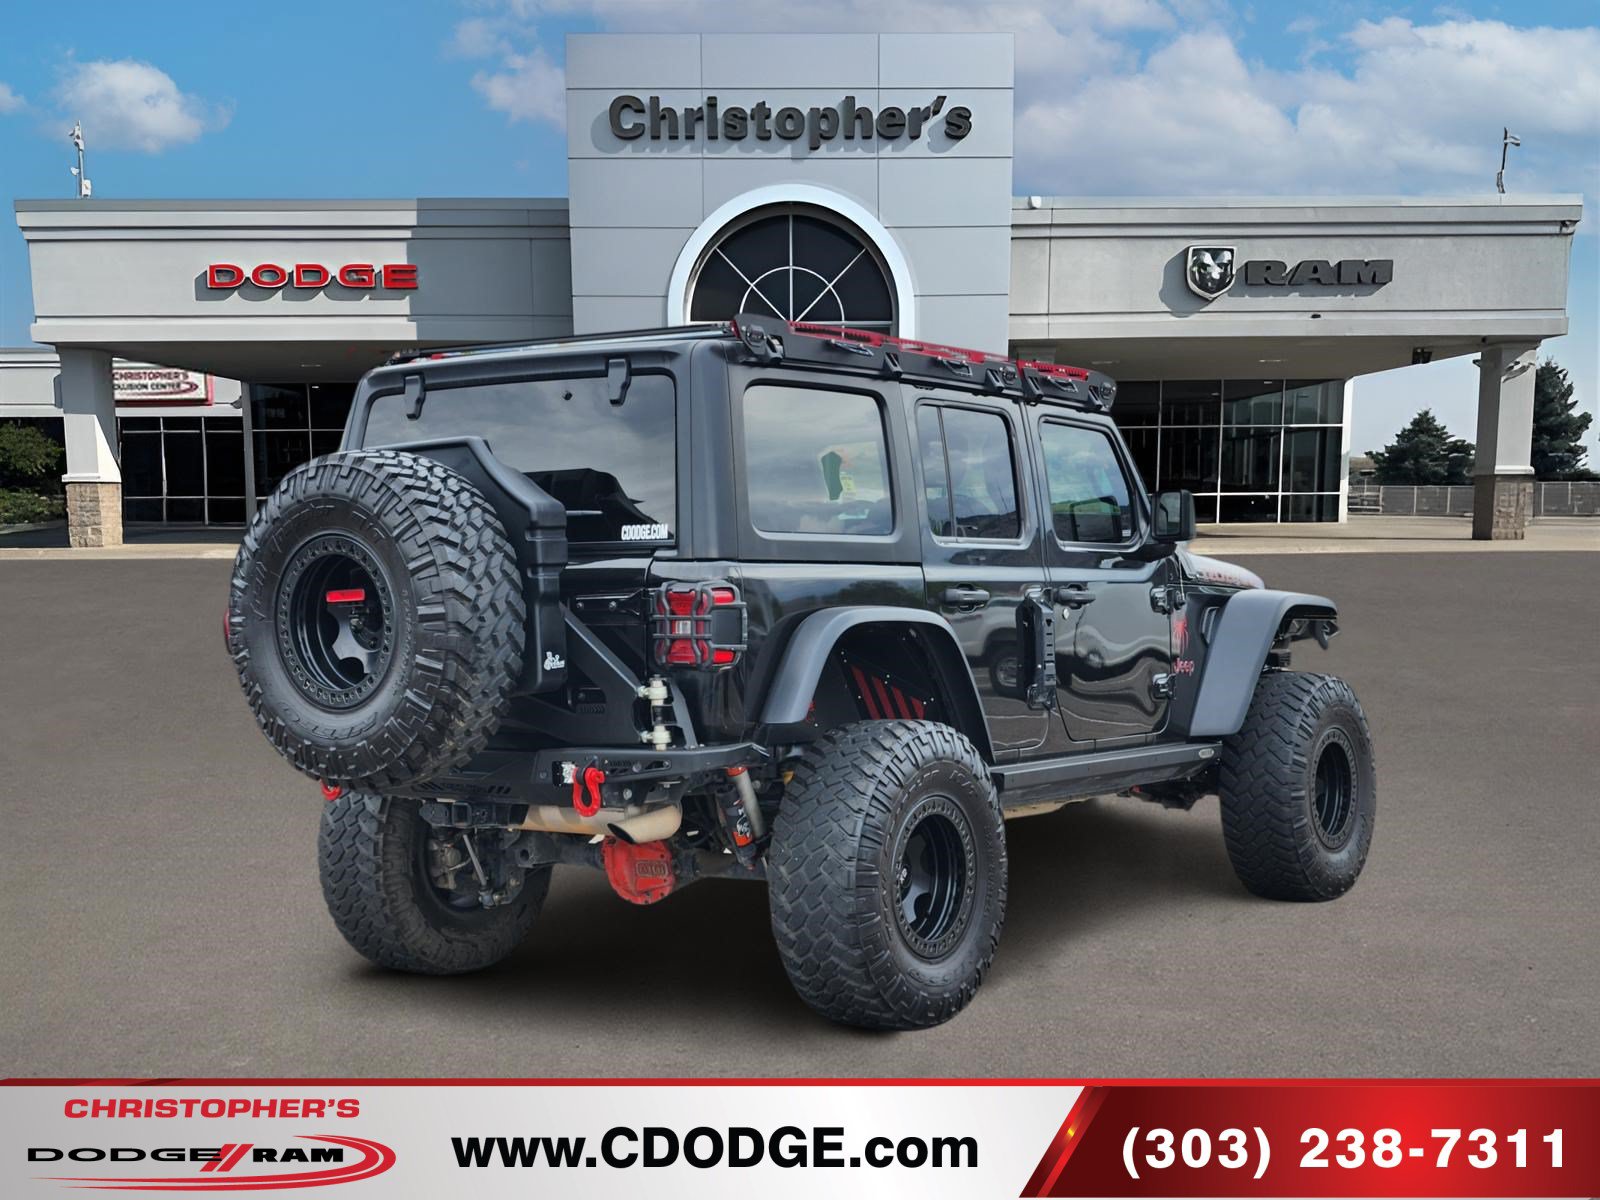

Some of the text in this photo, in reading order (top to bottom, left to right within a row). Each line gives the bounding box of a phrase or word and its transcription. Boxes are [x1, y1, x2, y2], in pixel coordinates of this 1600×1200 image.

[608, 94, 972, 151] Christopher's
[206, 263, 418, 289] DODGE
[1245, 259, 1394, 286] RAM
[112, 383, 149, 391] OLLISION
[621, 523, 669, 541] CDODGE.COM
